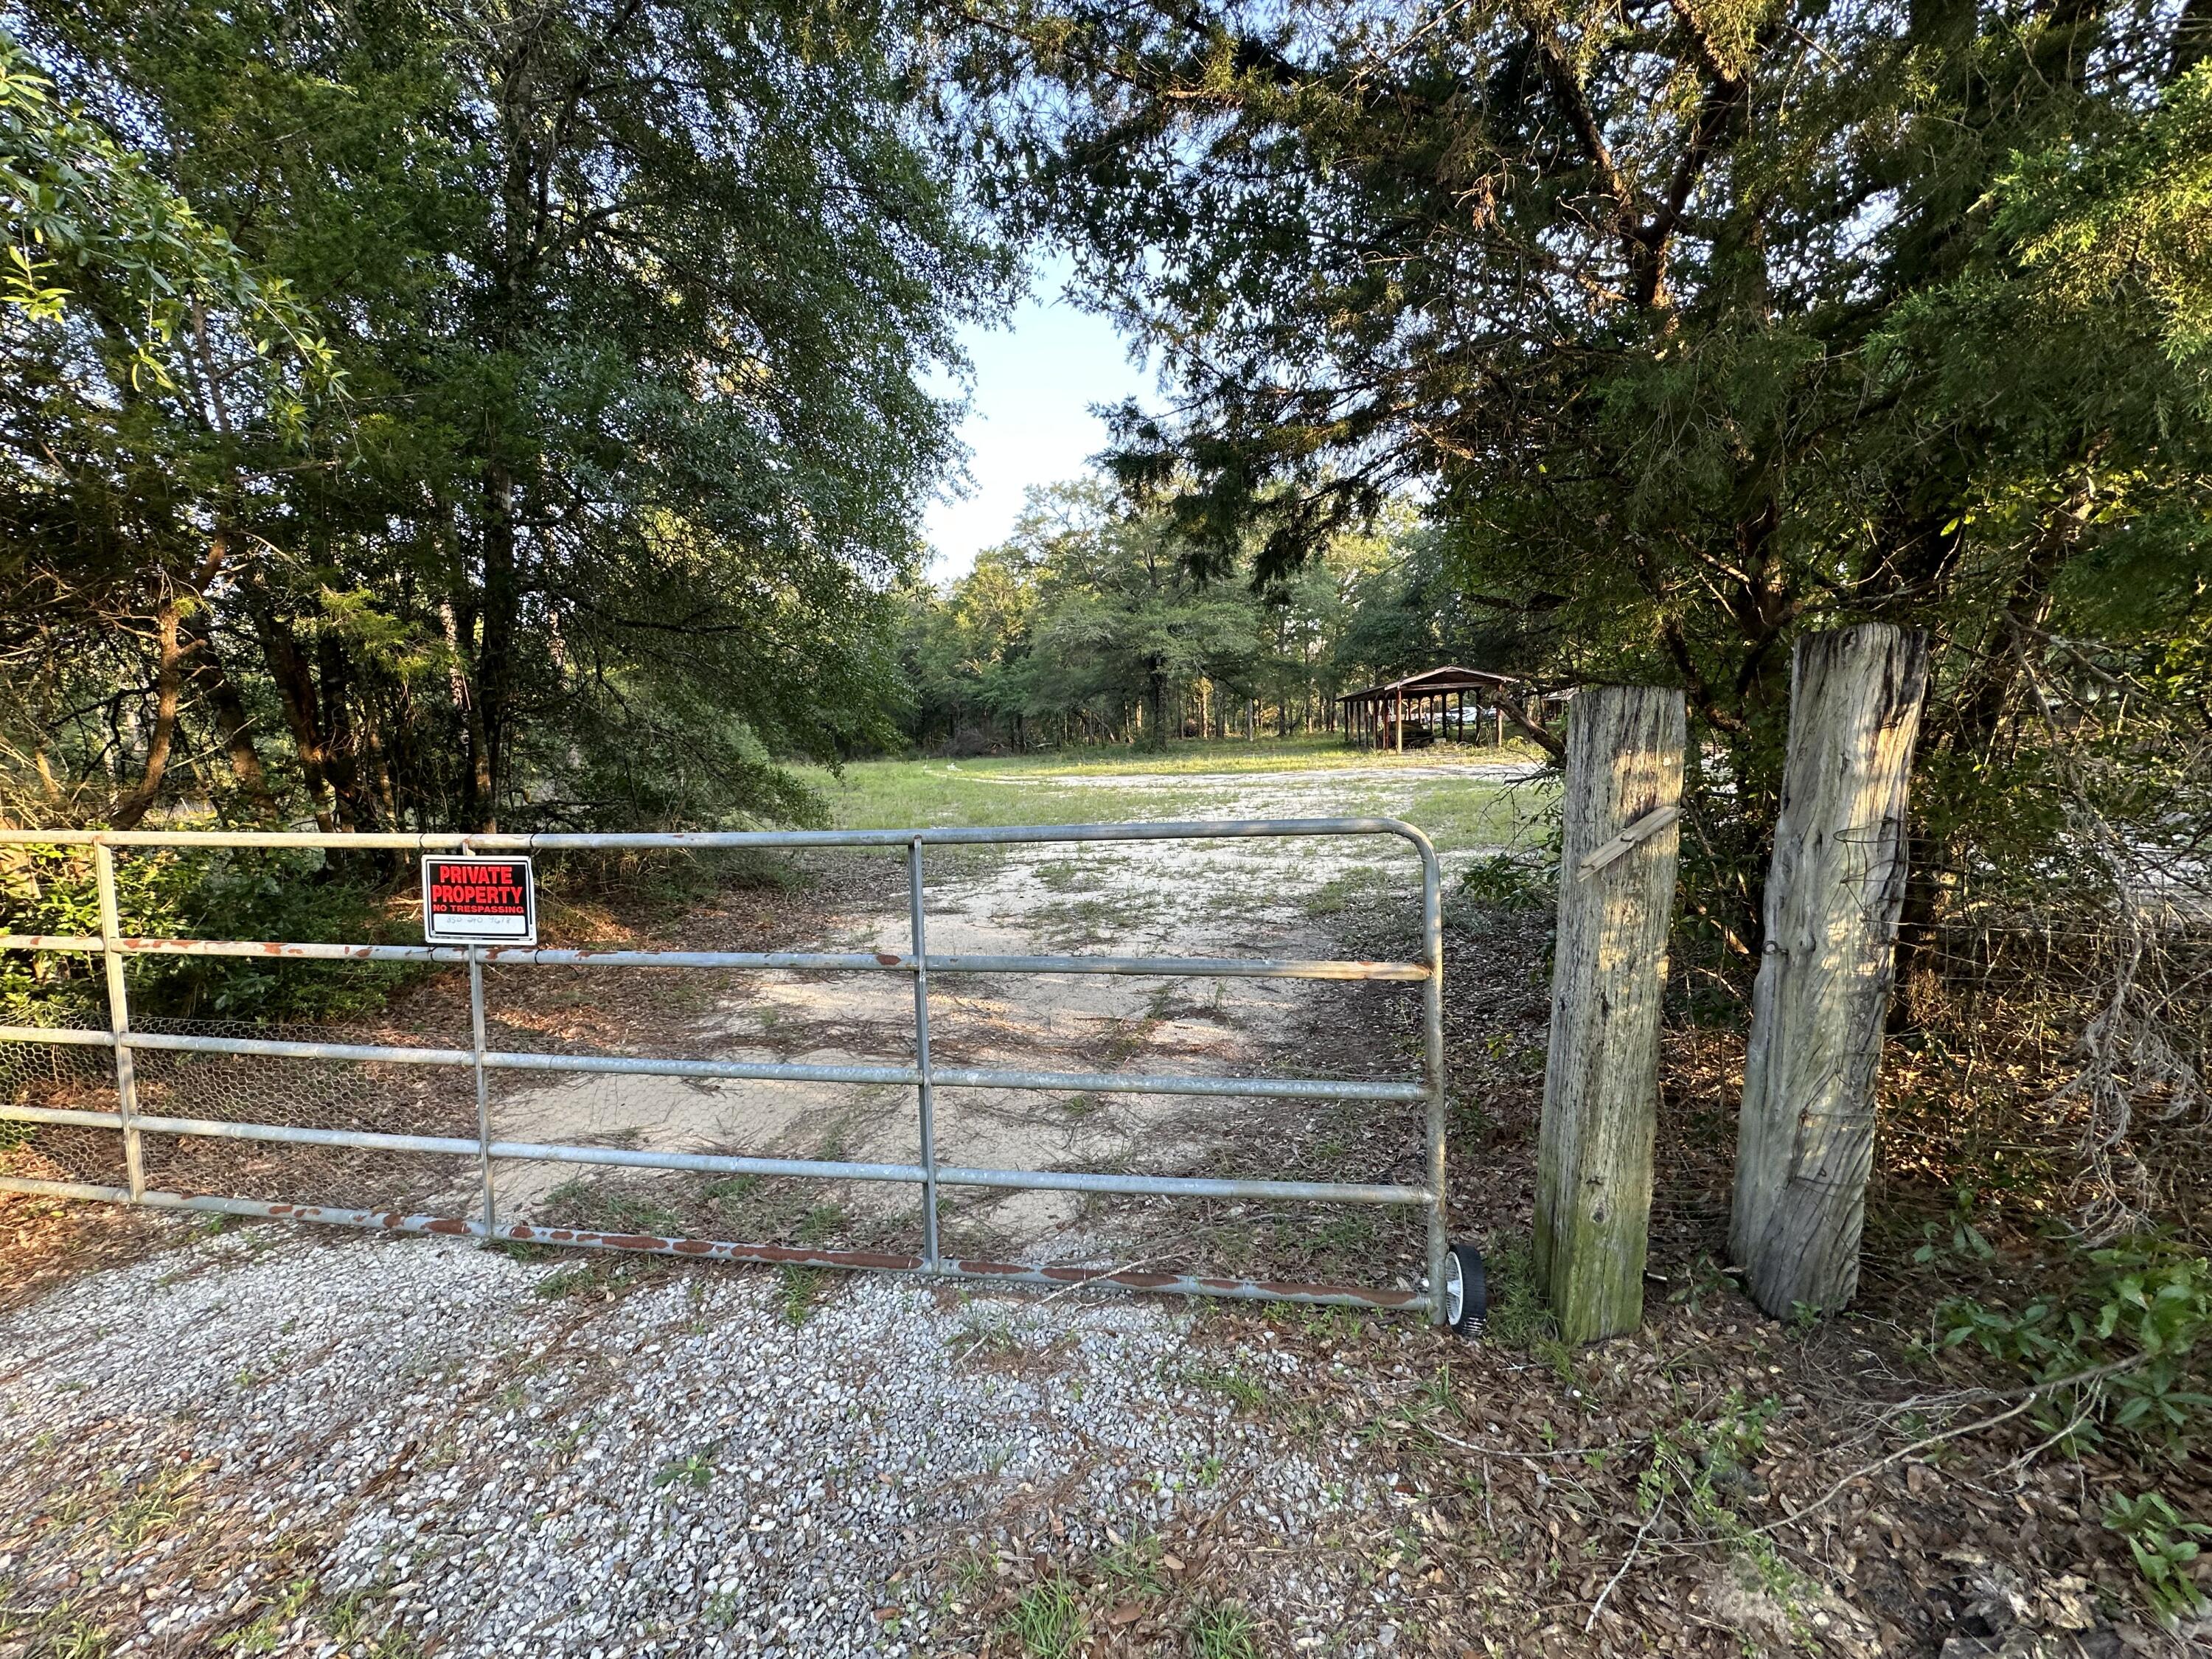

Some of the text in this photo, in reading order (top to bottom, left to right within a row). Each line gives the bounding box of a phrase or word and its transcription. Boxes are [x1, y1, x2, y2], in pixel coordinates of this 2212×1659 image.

[439, 866, 513, 884] PRIVATE
[432, 885, 523, 903] PROPERTY
[433, 904, 524, 914] NO TRESPASSING
